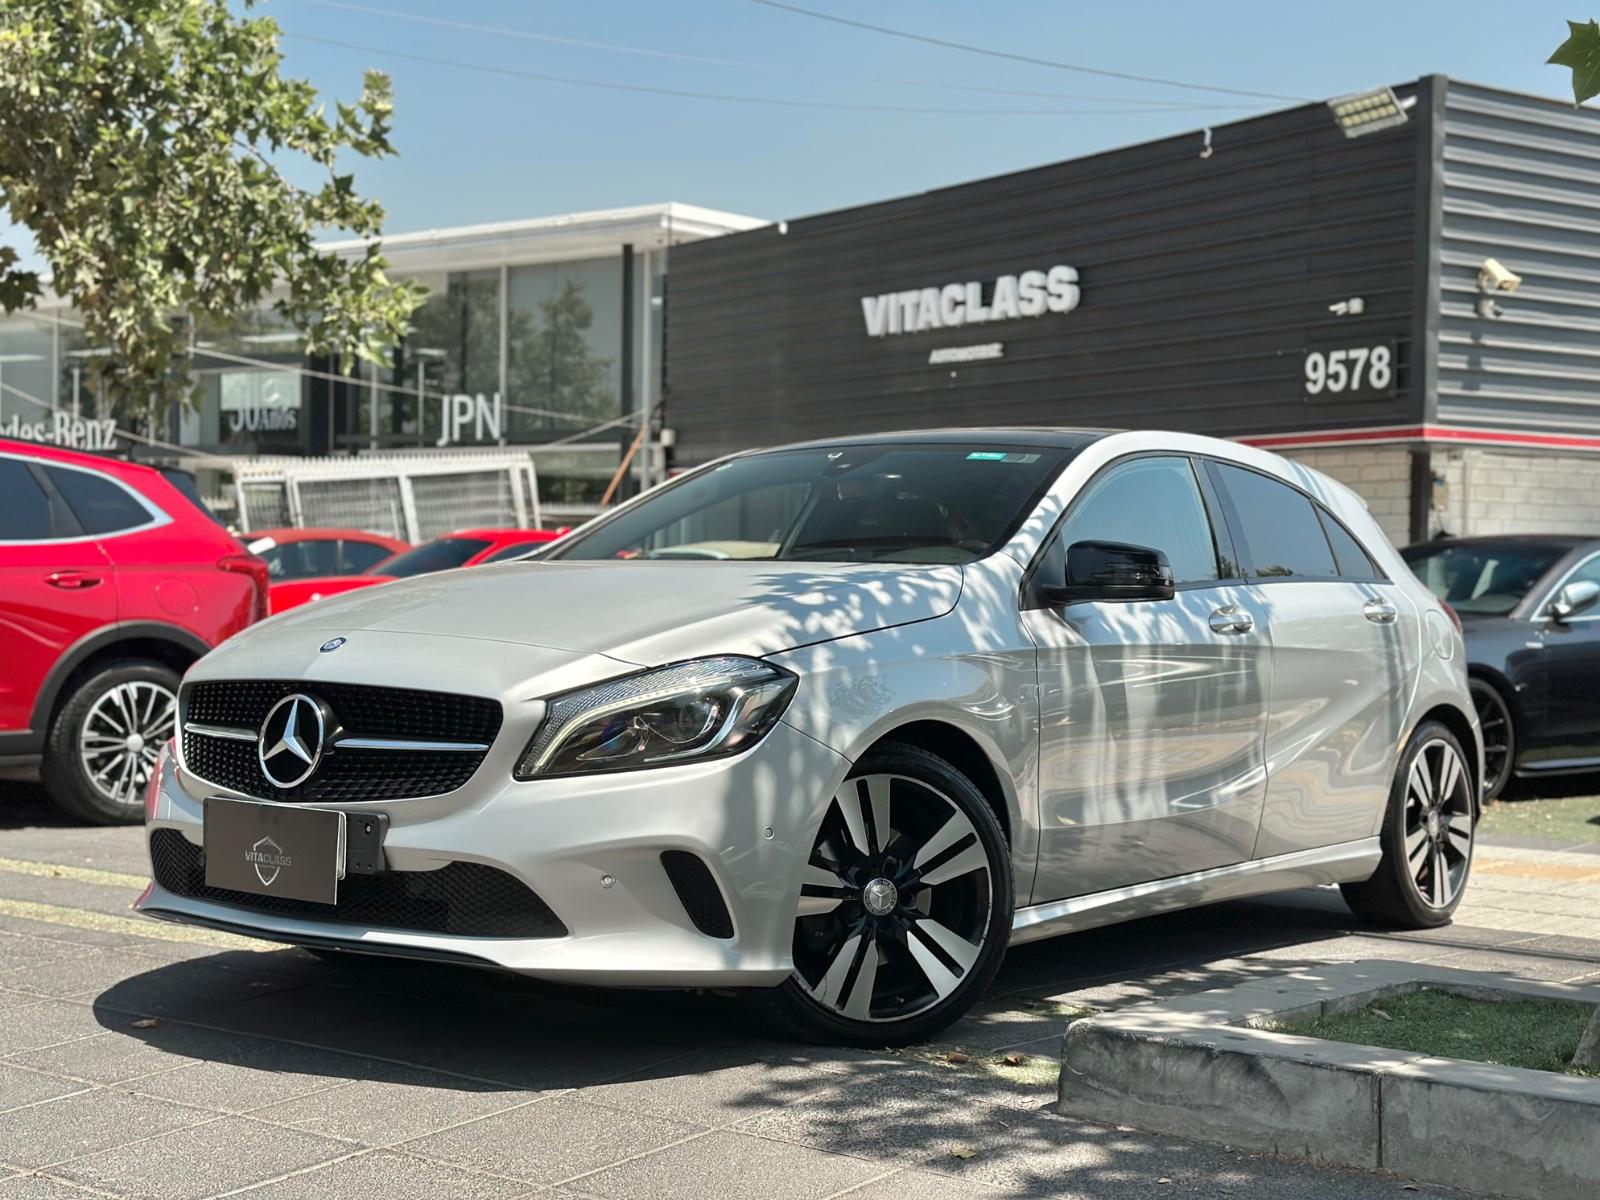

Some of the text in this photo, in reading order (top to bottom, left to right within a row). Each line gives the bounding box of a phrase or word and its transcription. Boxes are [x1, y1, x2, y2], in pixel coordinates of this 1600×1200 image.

[861, 265, 1080, 336] VITACLASS
[1305, 346, 1391, 394] 9578
[0, 411, 117, 450] des-Benz
[436, 391, 500, 447] JPN
[245, 851, 291, 866] VITACLASS
